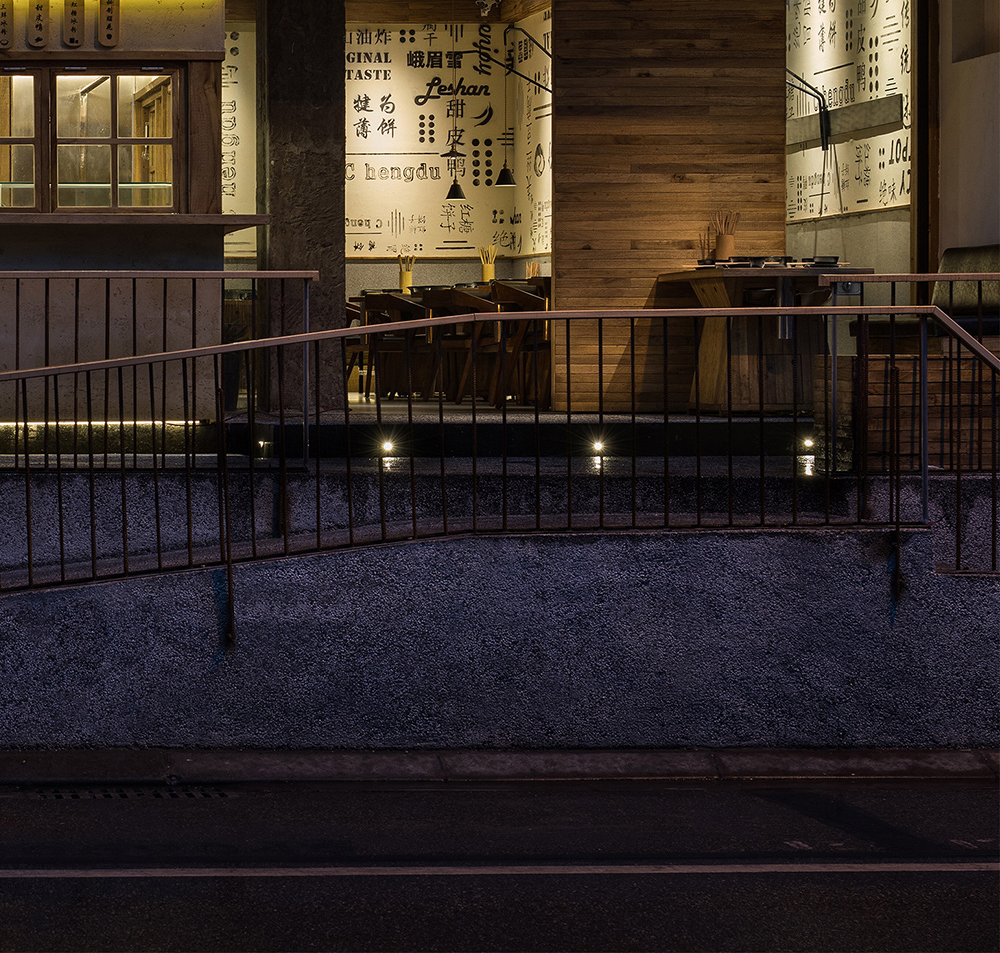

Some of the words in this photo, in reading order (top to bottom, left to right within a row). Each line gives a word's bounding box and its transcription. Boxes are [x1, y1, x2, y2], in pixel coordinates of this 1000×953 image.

[406, 50, 463, 69] 峨眉雪
[472, 24, 499, 76] enjoy
[345, 69, 392, 81] TASTE
[414, 76, 491, 106] Leshan
[364, 162, 442, 183] hengdu
